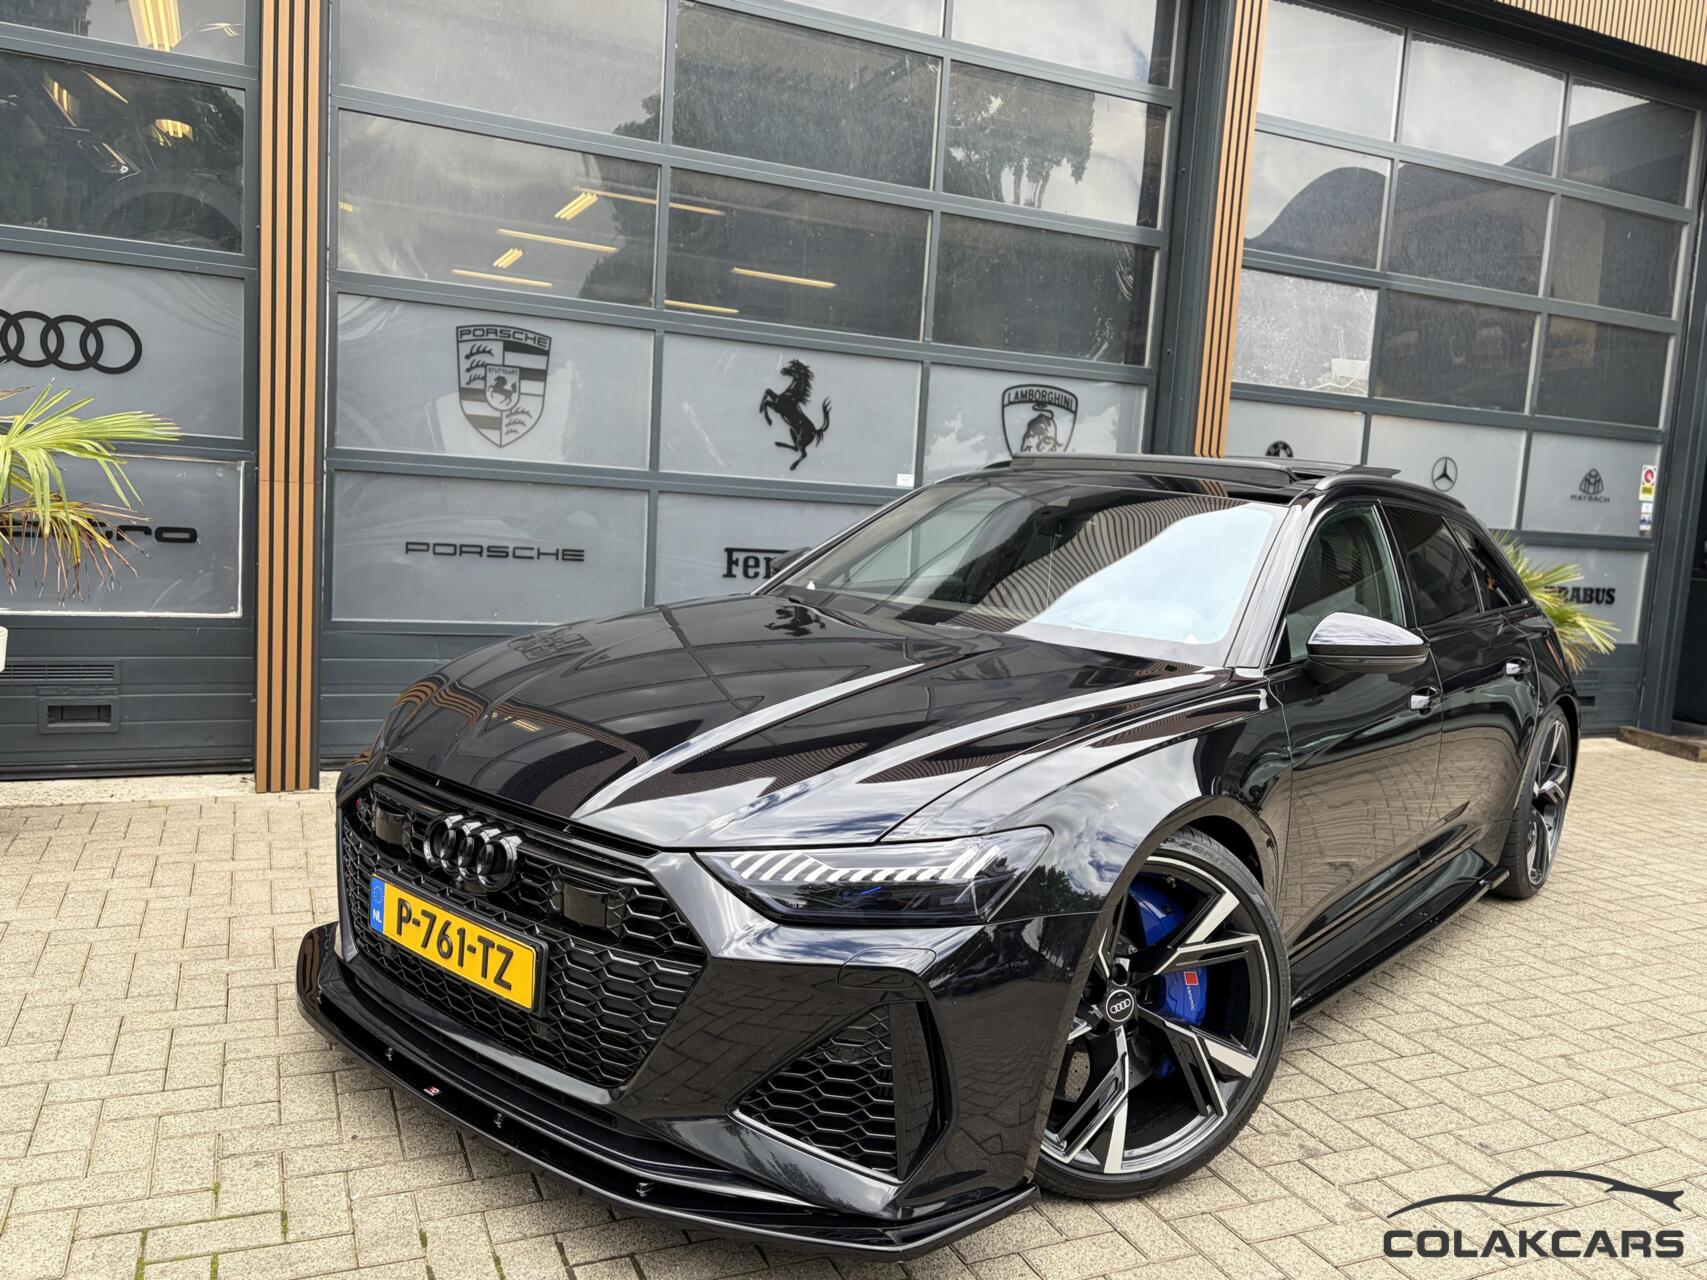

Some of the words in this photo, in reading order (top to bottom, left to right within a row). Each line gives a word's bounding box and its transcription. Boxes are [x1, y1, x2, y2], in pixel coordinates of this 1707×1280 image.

[459, 328, 548, 348] PORSCHE
[488, 367, 518, 375] STUTTGART
[1007, 388, 1073, 410] LAMBORGHINI
[1570, 494, 1610, 503] MAYBACH
[405, 541, 585, 562] PORSCHE
[722, 547, 780, 579] Fer
[372, 908, 382, 924] NL
[396, 897, 514, 992] P-761-TZ
